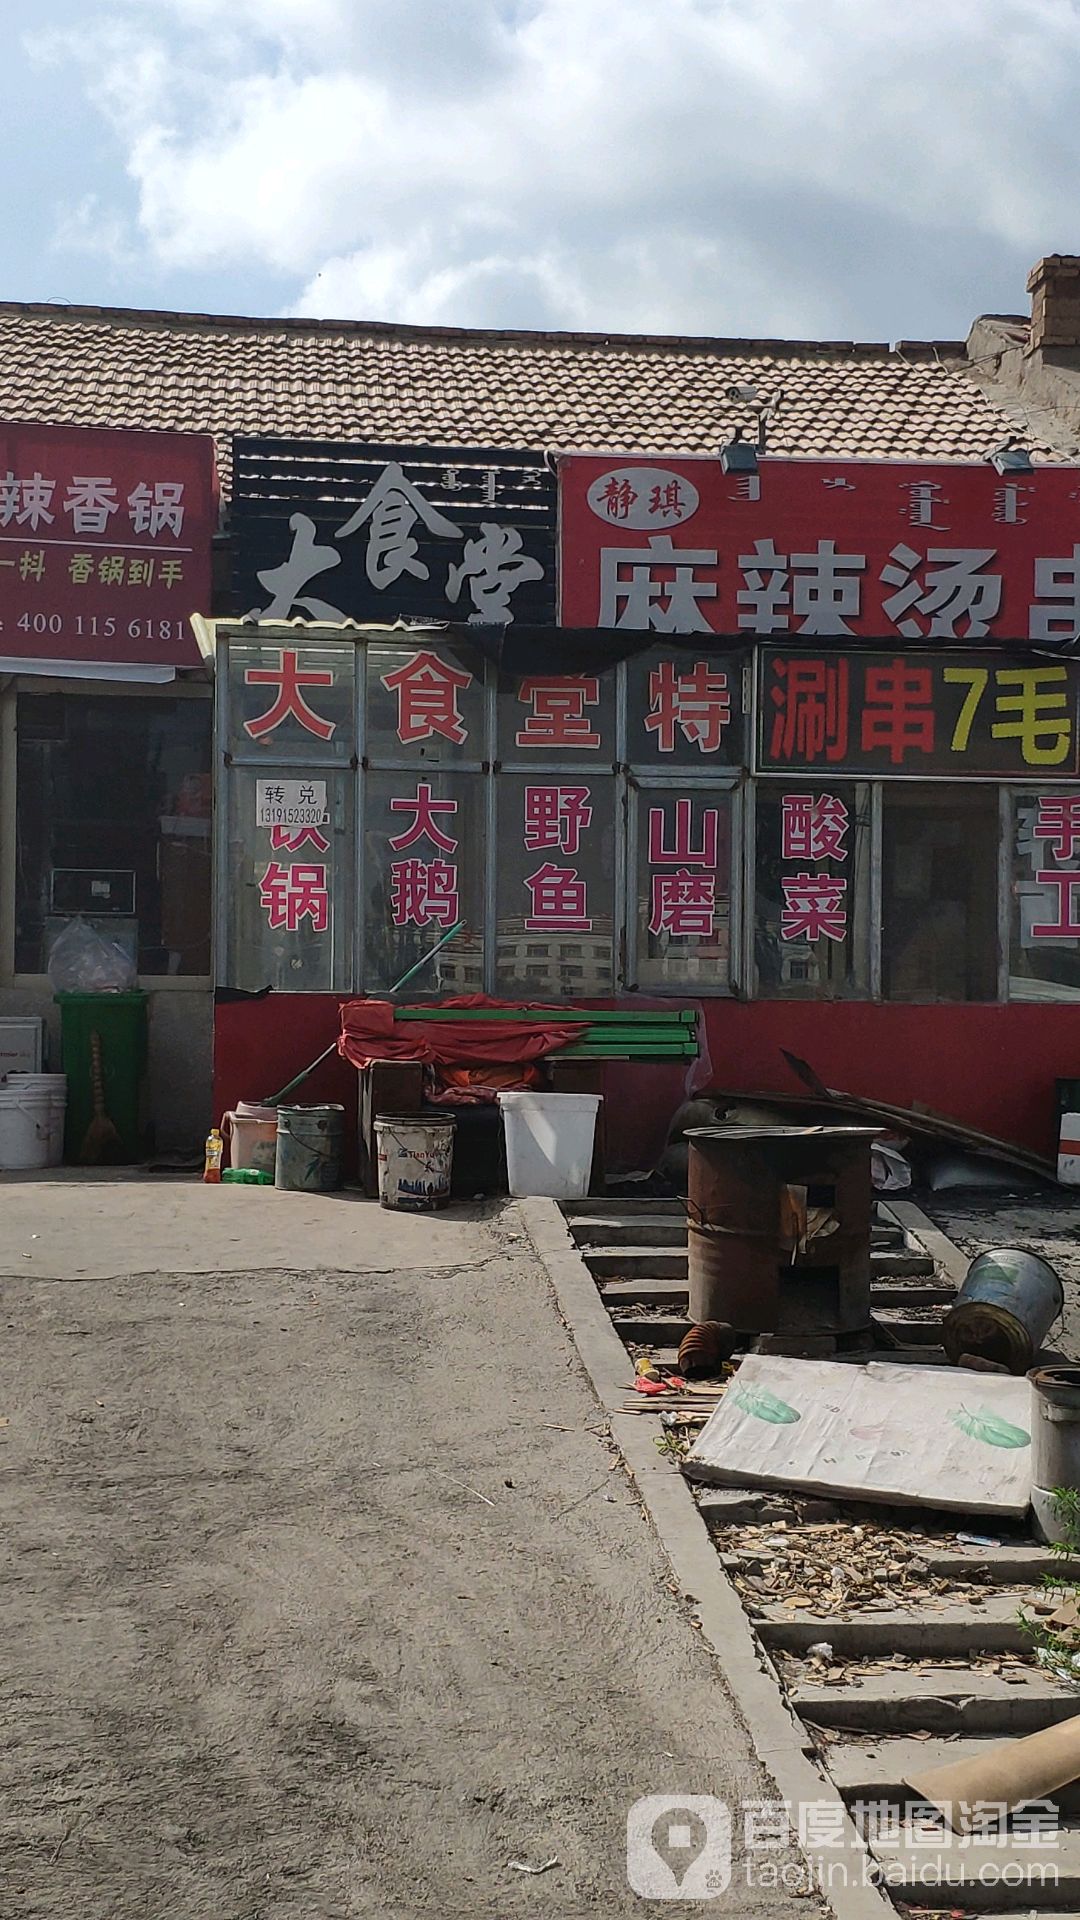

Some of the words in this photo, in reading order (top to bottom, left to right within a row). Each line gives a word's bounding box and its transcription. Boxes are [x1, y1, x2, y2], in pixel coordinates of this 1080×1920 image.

[0, 471, 184, 539] 辣香锅
[597, 477, 686, 520] 静琪
[250, 461, 545, 624] 大食堂
[68, 553, 184, 590] 香锅到手
[17, 612, 63, 634] 400
[75, 615, 116, 637] 115
[128, 618, 185, 640] 6181
[770, 657, 1070, 765] 涮串7毛
[261, 808, 321, 823] 13191523320
